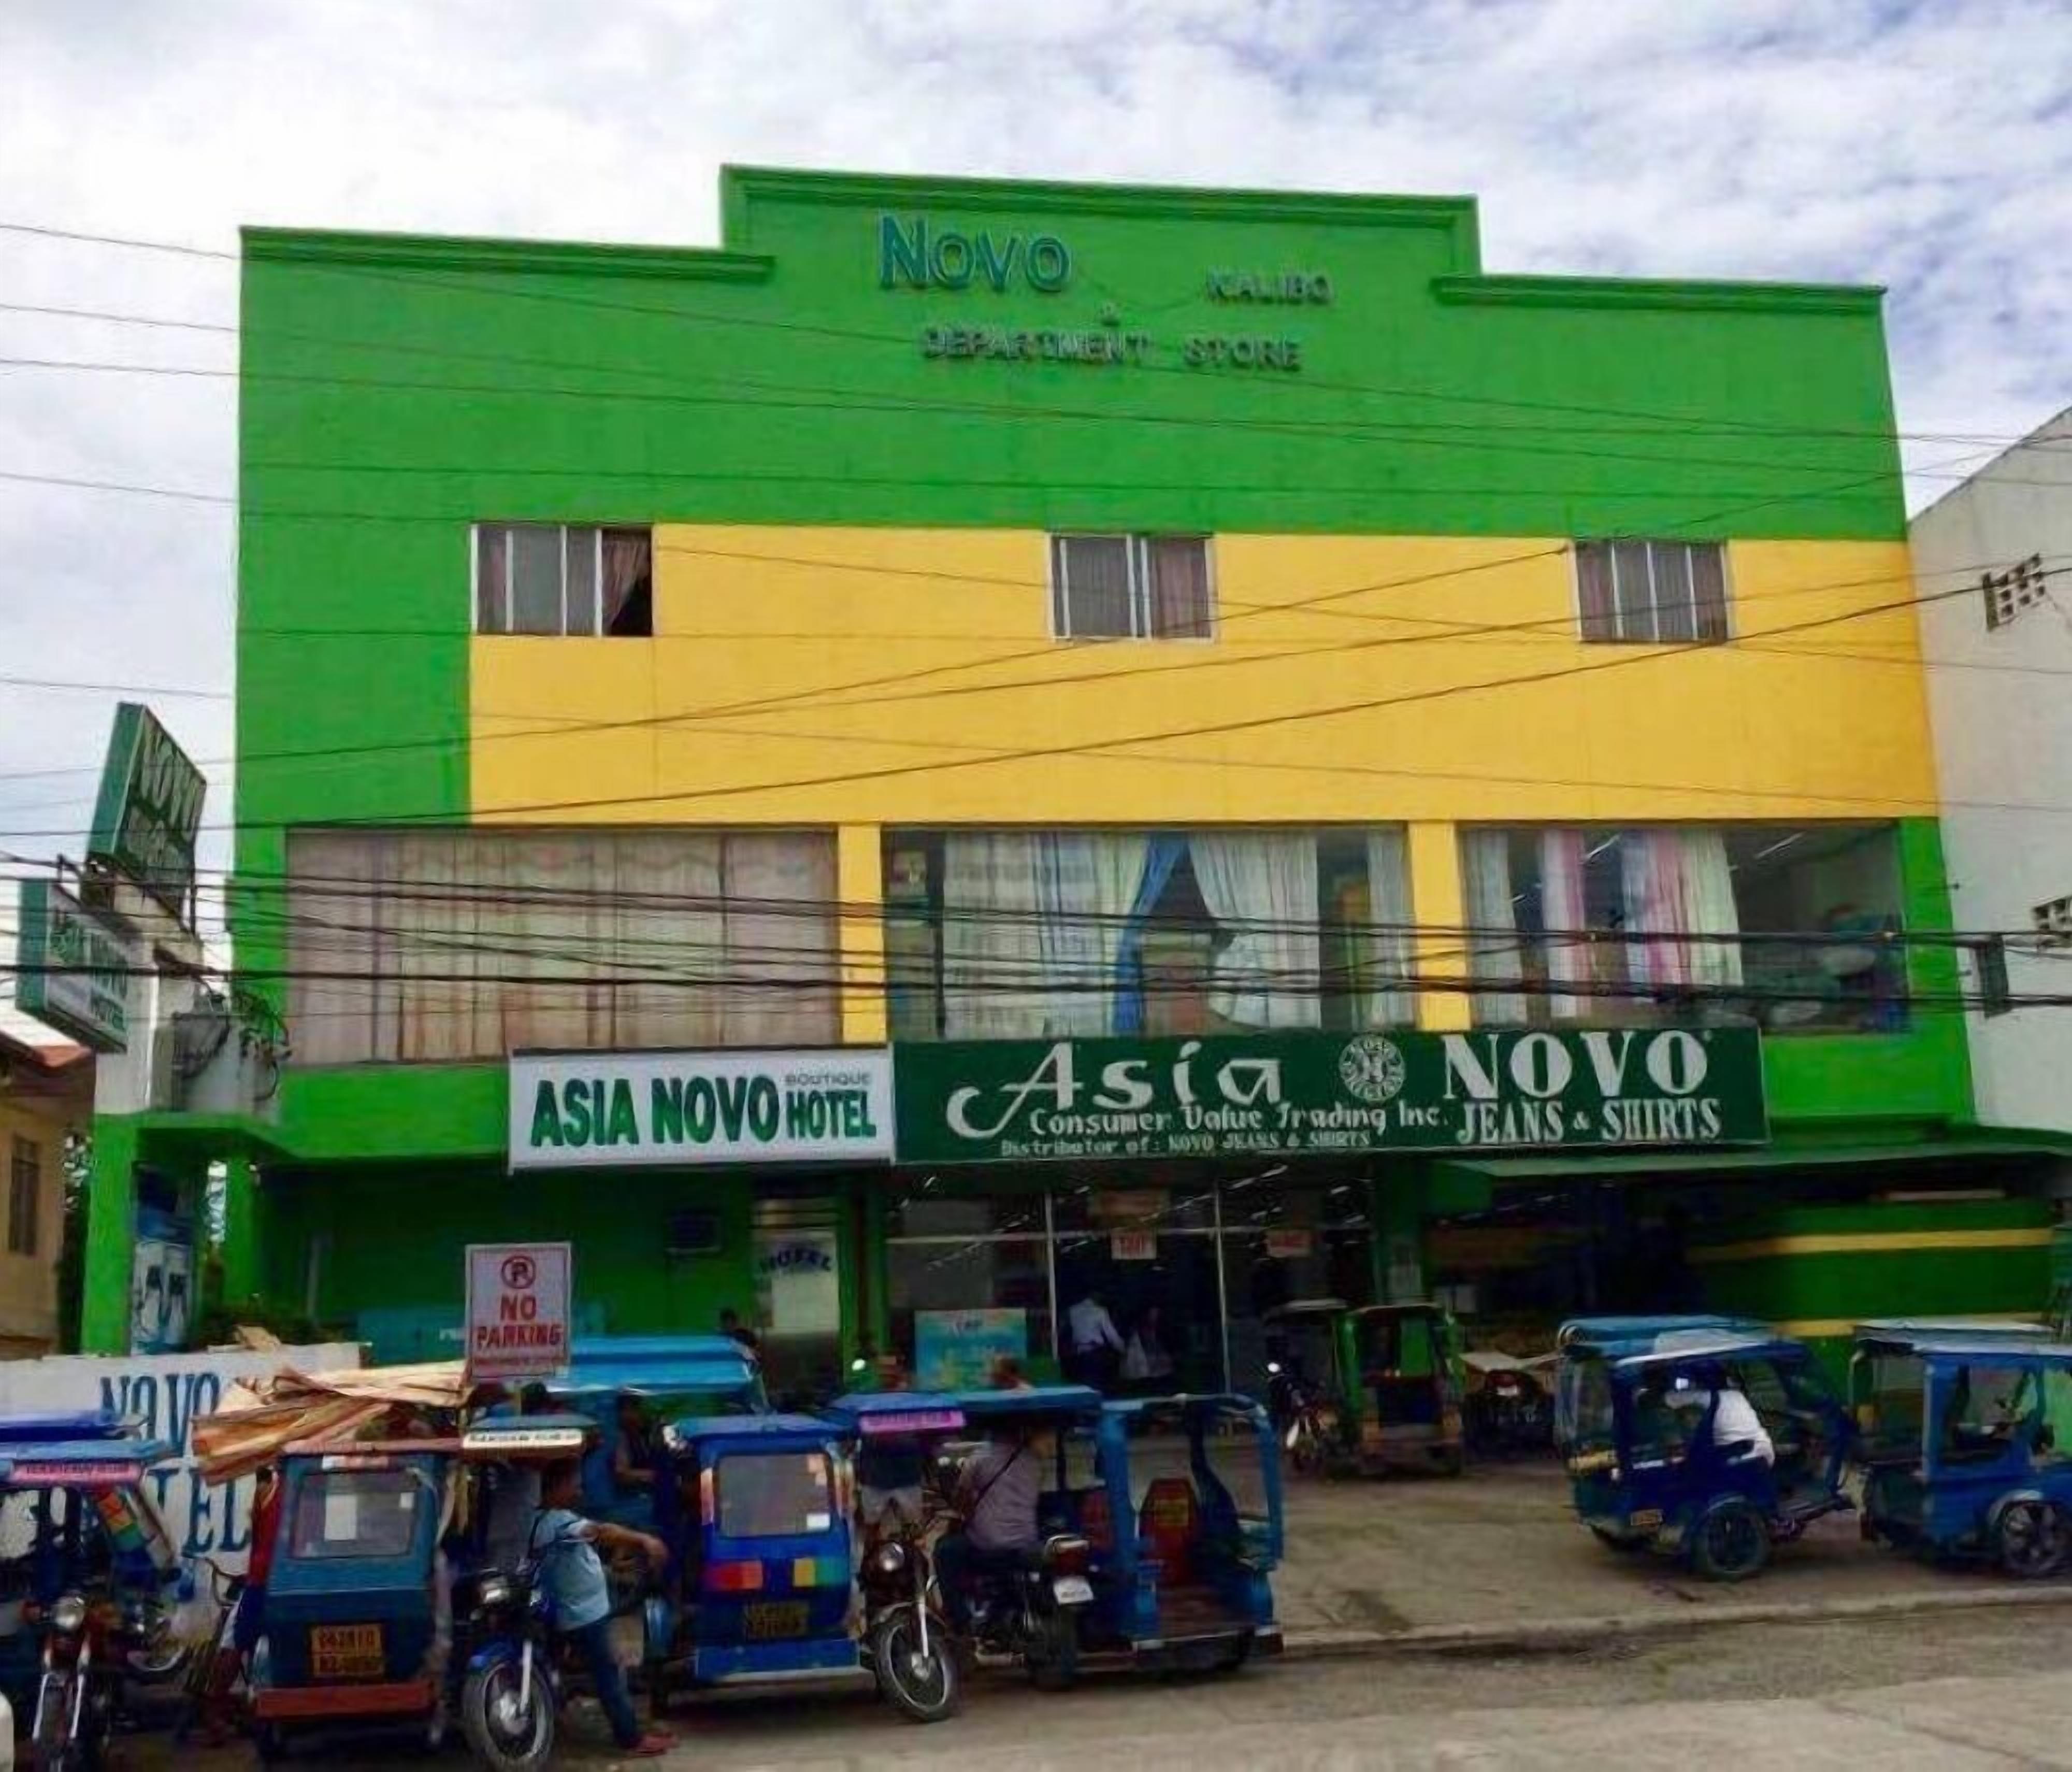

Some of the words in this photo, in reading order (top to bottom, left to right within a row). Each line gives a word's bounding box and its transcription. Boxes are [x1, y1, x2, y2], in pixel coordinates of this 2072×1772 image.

[924, 324, 1153, 363] DEPARTMENT
[1183, 333, 1301, 370] STORE
[1442, 1031, 1708, 1099] NOVO
[530, 1078, 639, 1147] ASIA
[651, 1075, 780, 1145] NOVO
[786, 1090, 877, 1139] HOTEL
[946, 1040, 1284, 1138] Asia
[1030, 1109, 1167, 1135] Consumer
[1185, 1105, 1262, 1131] Value
[1277, 1102, 1386, 1137] Trading
[1457, 1100, 1564, 1146] JEANS
[1573, 1112, 1590, 1131] &
[1601, 1098, 1722, 1142] SHIRTS
[500, 1294, 537, 1321] NO
[477, 1324, 563, 1348] PARKING
